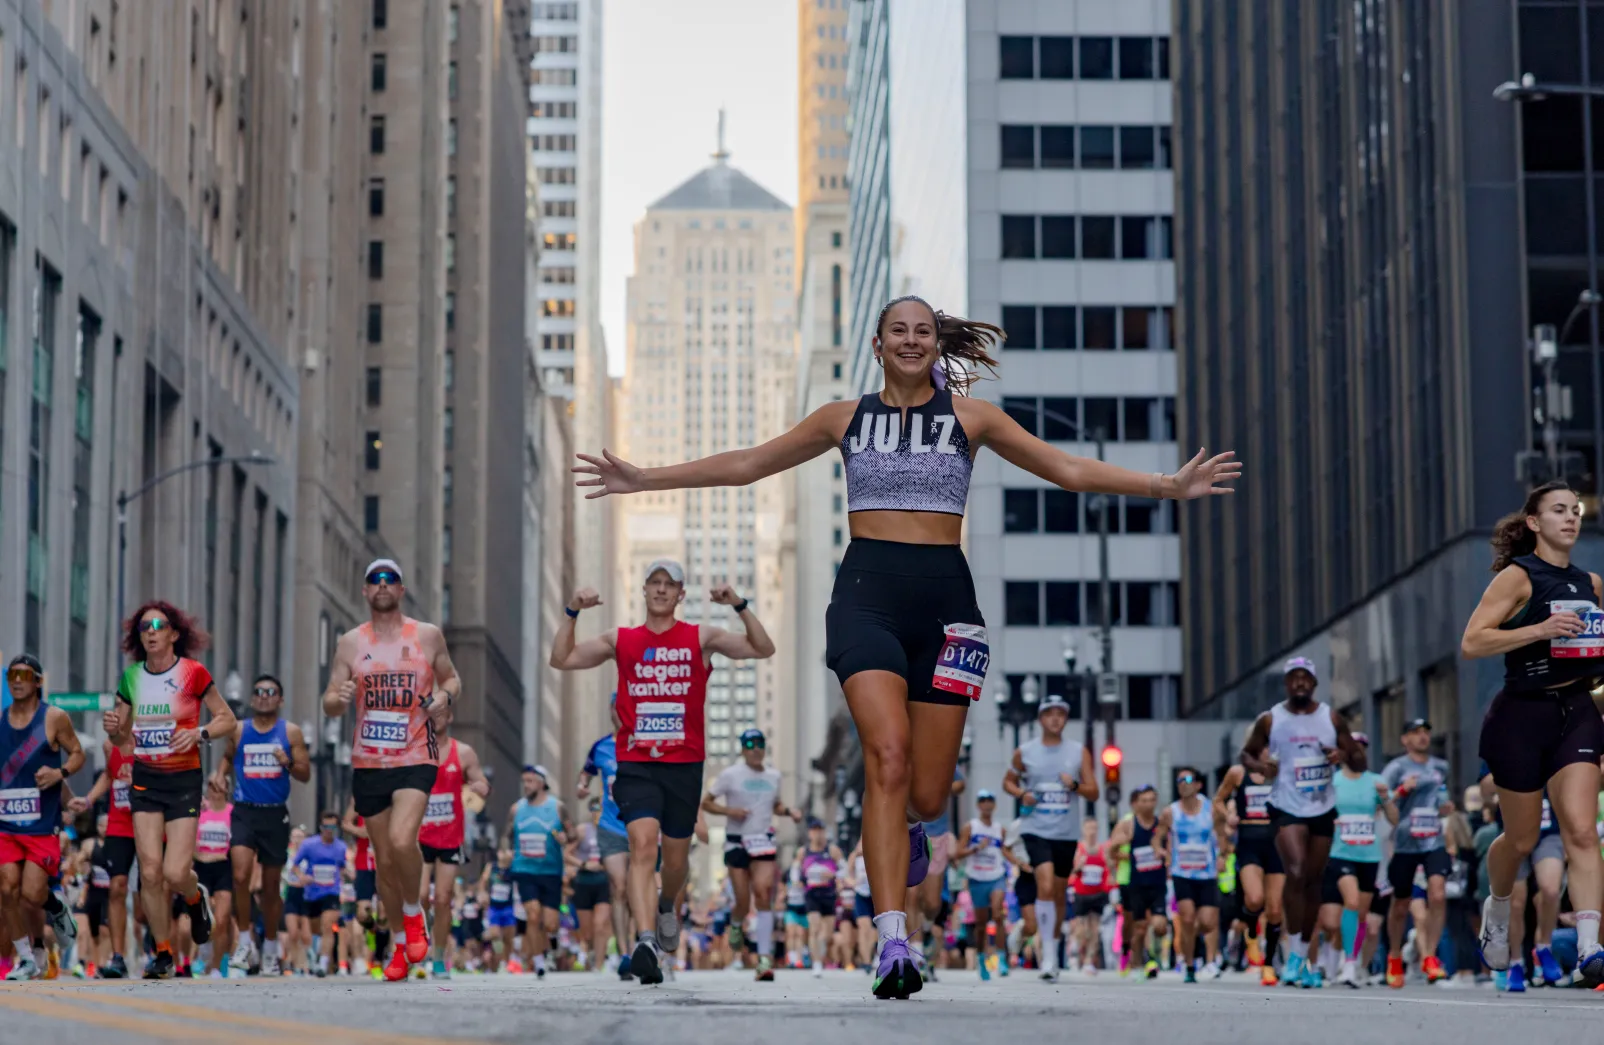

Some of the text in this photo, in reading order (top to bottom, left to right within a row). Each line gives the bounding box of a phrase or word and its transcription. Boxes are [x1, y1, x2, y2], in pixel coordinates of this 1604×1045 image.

[850, 412, 957, 454] JULZ
[634, 662, 691, 682] tegen
[364, 673, 415, 689] STREET
[627, 680, 691, 696] kanker
[365, 689, 413, 708] CHILD
[137, 703, 171, 715] ILENIA
